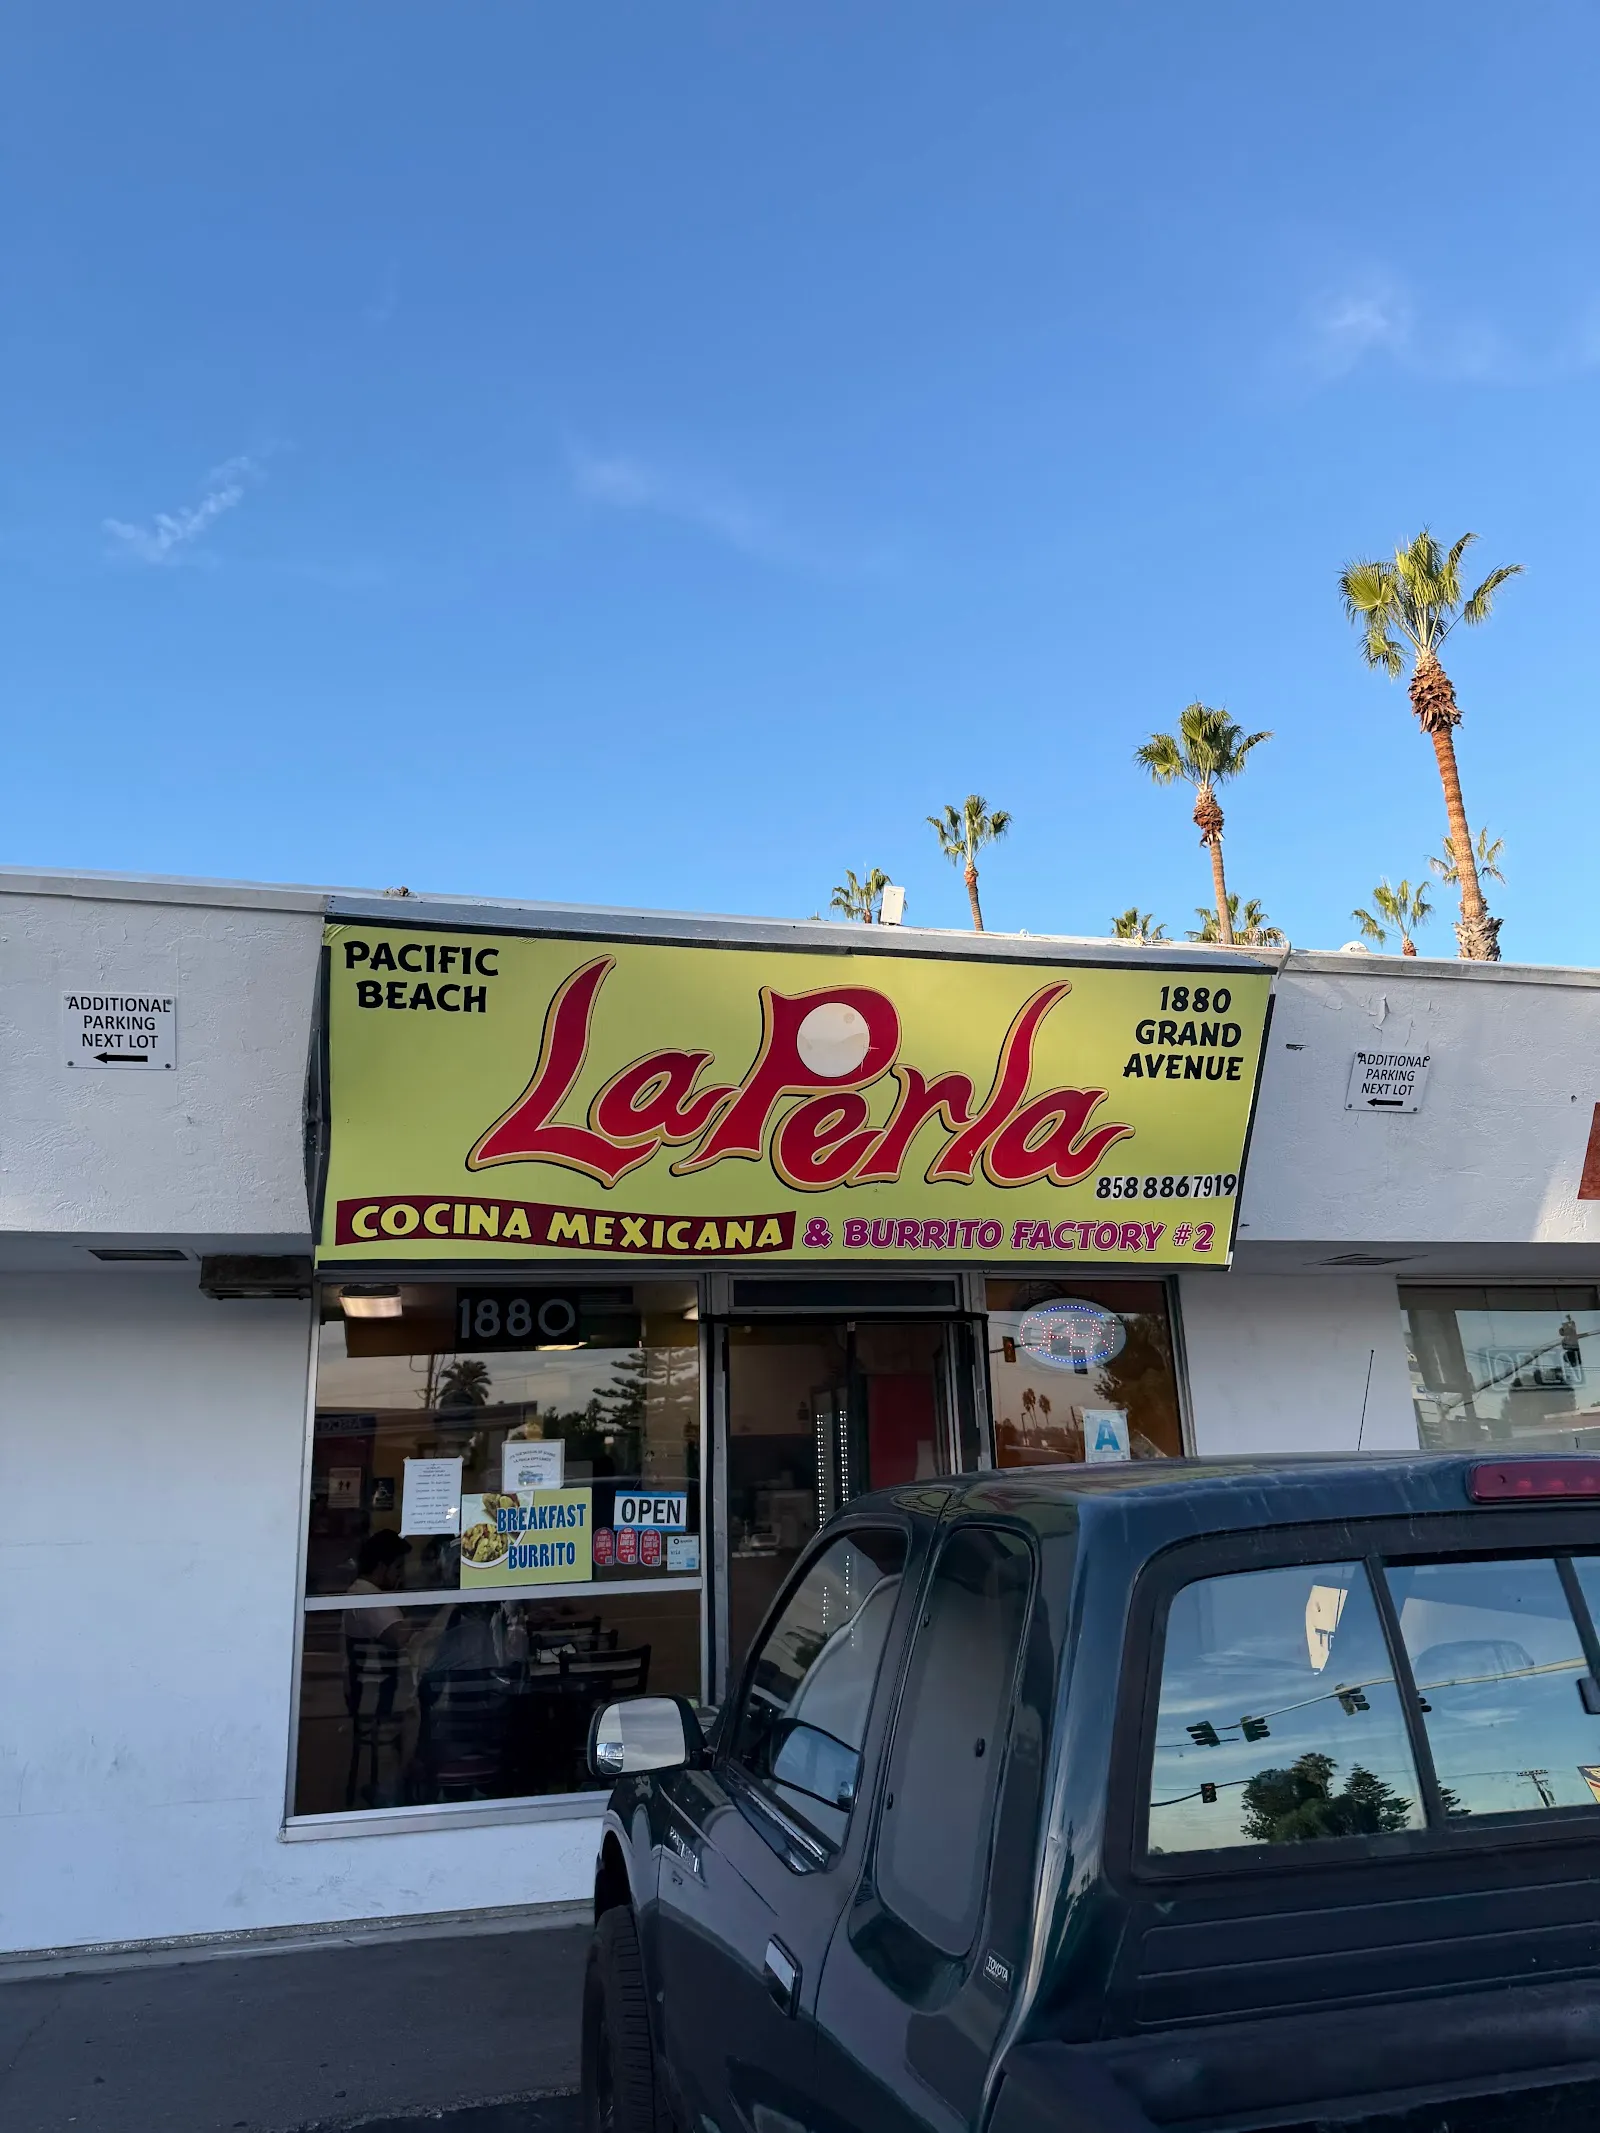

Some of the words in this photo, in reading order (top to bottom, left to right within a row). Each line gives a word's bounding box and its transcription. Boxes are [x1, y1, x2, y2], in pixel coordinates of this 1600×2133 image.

[343, 940, 500, 977] PACIFIC
[68, 996, 171, 1013] ADDITIONAL
[356, 980, 487, 1013] BEACH
[1160, 985, 1232, 1014] 1880
[83, 1015, 156, 1031] PARKING
[1135, 1019, 1242, 1048] GRAND
[82, 1033, 124, 1048] NEXT
[129, 1034, 159, 1049] LOT
[1122, 1053, 1244, 1081] AVENUE
[1359, 1053, 1428, 1068] ADDITIONAL
[1361, 1082, 1392, 1095] NEXT
[1393, 1084, 1415, 1096] LOT
[1366, 1068, 1416, 1082] PARKING
[351, 1202, 533, 1241] COCINA
[546, 1211, 784, 1251] MEXICANA
[802, 1217, 832, 1249] &
[843, 1218, 1004, 1252] BURRITO
[1010, 1219, 1167, 1253] FACTORY
[1172, 1222, 1216, 1253] #2
[459, 1299, 576, 1339] 1880
[1020, 1316, 1116, 1353] OPEN
[1094, 1419, 1121, 1452] A
[497, 1504, 587, 1532] BREAKFAST
[621, 1498, 681, 1524] OPEN
[508, 1542, 575, 1570] BURRITO
[988, 1955, 1009, 1982] TOYOTA
